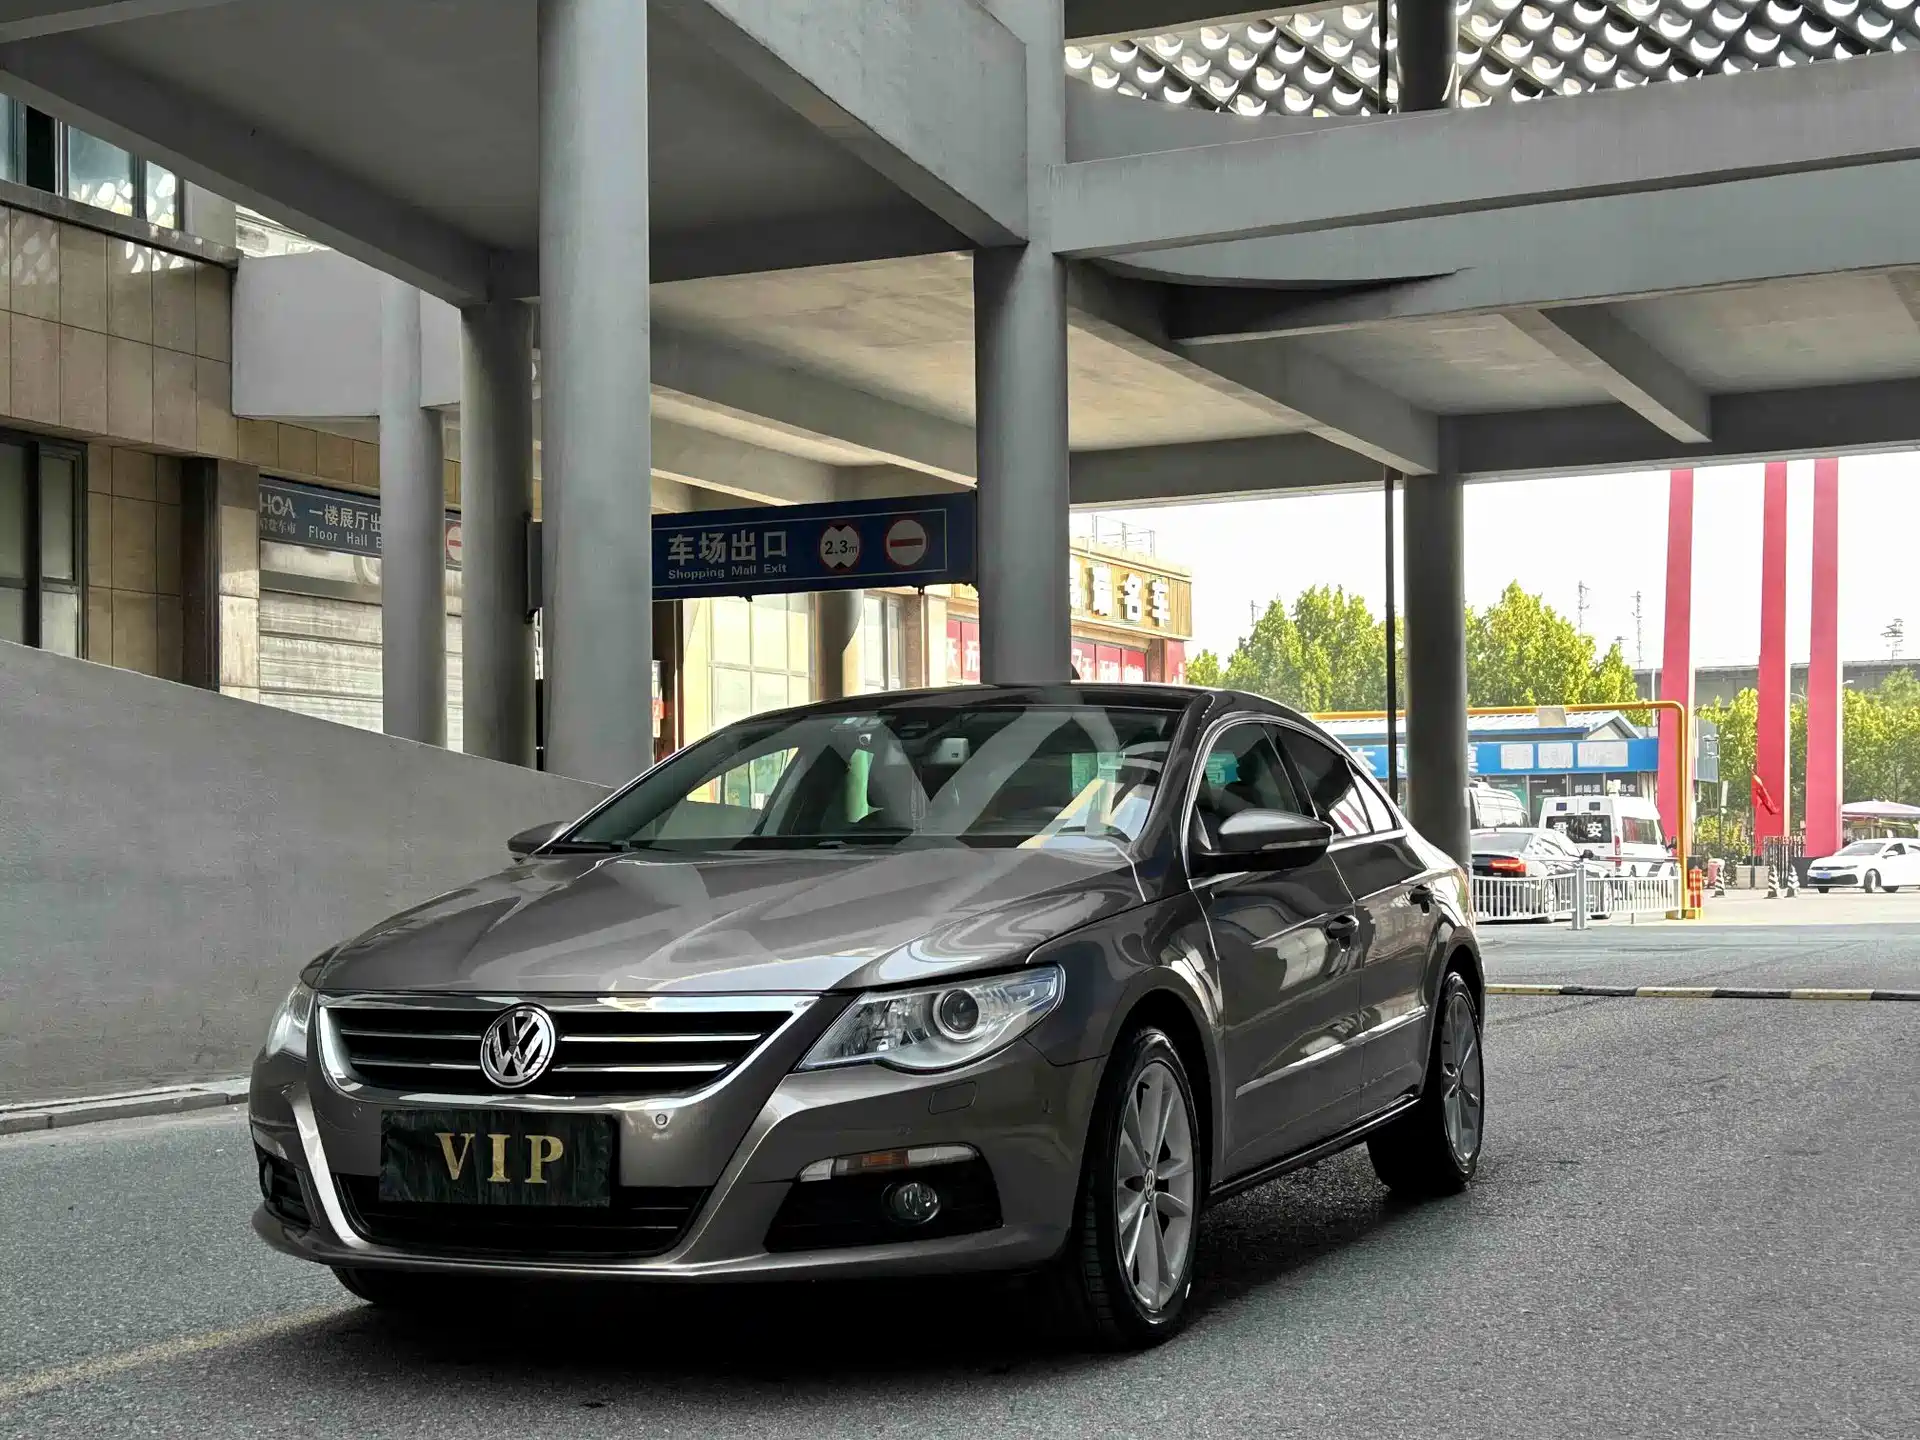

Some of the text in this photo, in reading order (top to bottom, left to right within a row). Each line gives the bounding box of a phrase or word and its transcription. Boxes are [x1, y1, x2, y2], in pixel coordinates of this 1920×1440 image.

[308, 525, 338, 542] Floor
[346, 532, 368, 547] Hall
[668, 529, 787, 566] 车场出口
[824, 539, 858, 556] 2.3m
[668, 563, 787, 580] Shopping Mall Exit
[435, 1132, 564, 1184] VIP
